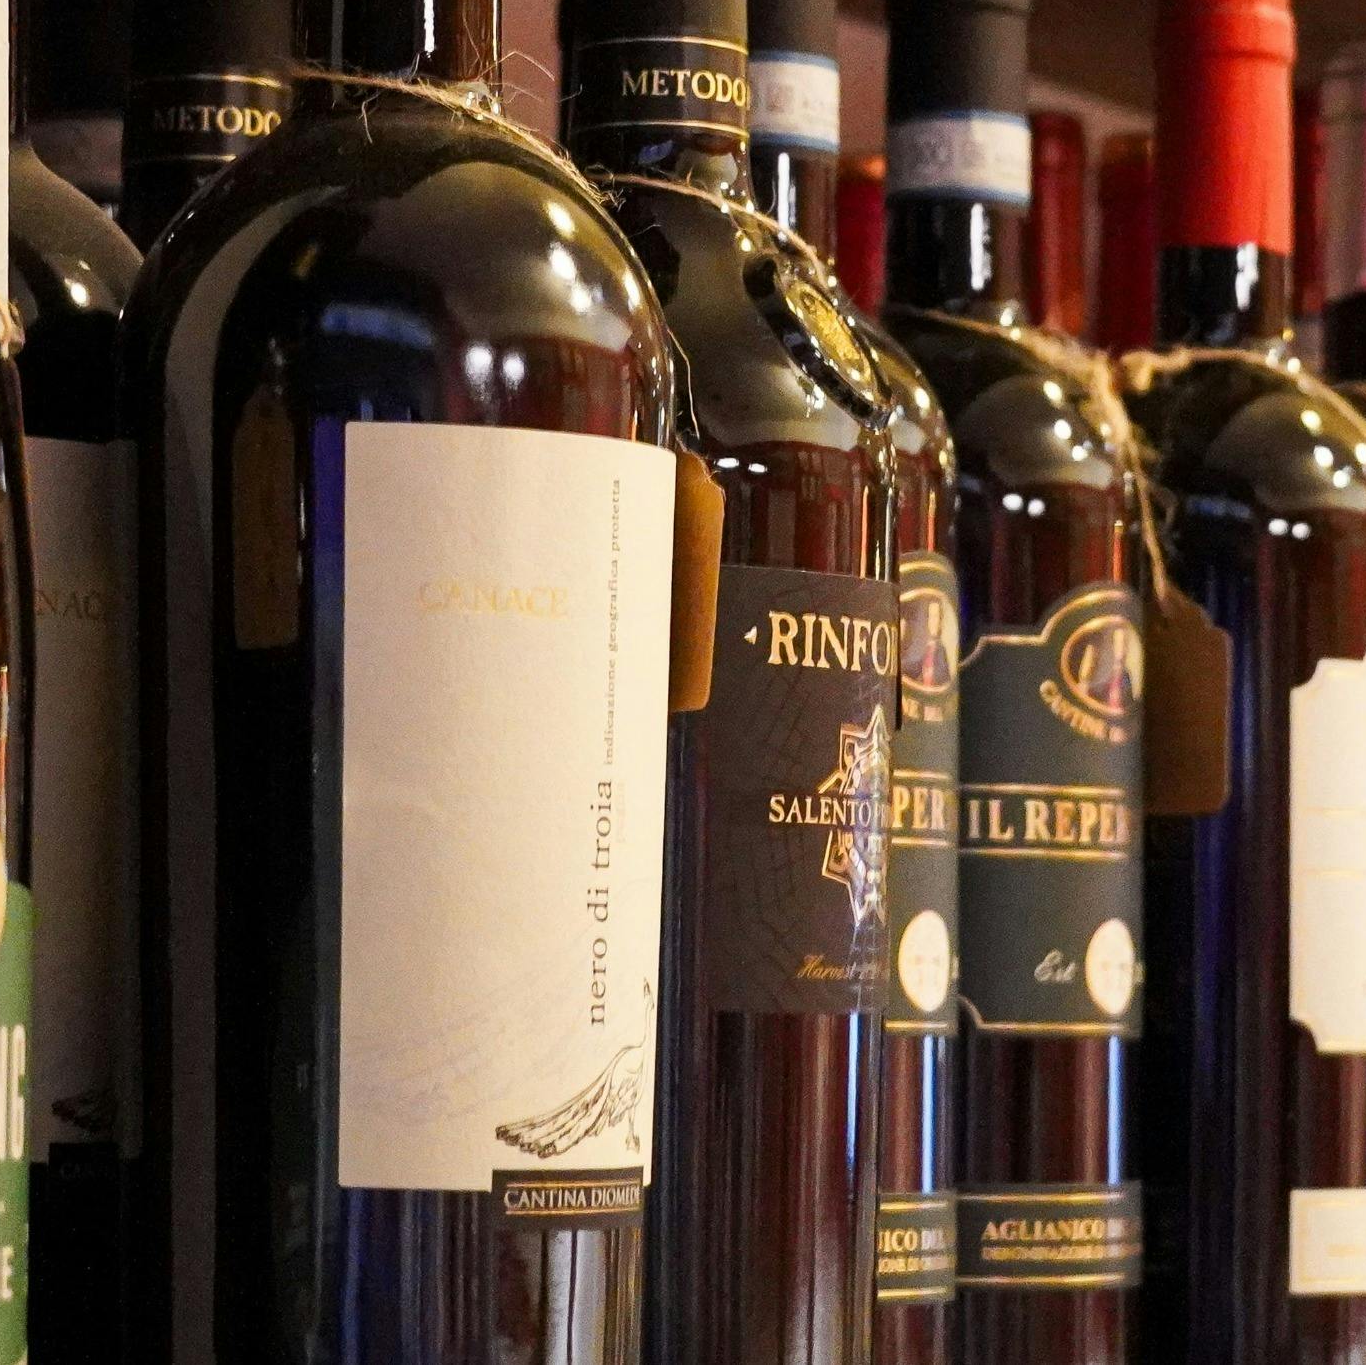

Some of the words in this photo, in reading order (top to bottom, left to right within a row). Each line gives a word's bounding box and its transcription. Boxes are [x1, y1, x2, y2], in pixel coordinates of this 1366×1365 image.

[622, 69, 747, 108] METODO
[767, 610, 898, 676] RINFO
[591, 778, 612, 869] troia
[768, 793, 871, 828] SALENTO
[967, 798, 1014, 841] IL
[587, 886, 609, 923] di
[590, 937, 608, 1026] nero
[504, 1187, 587, 1210] CANTINA
